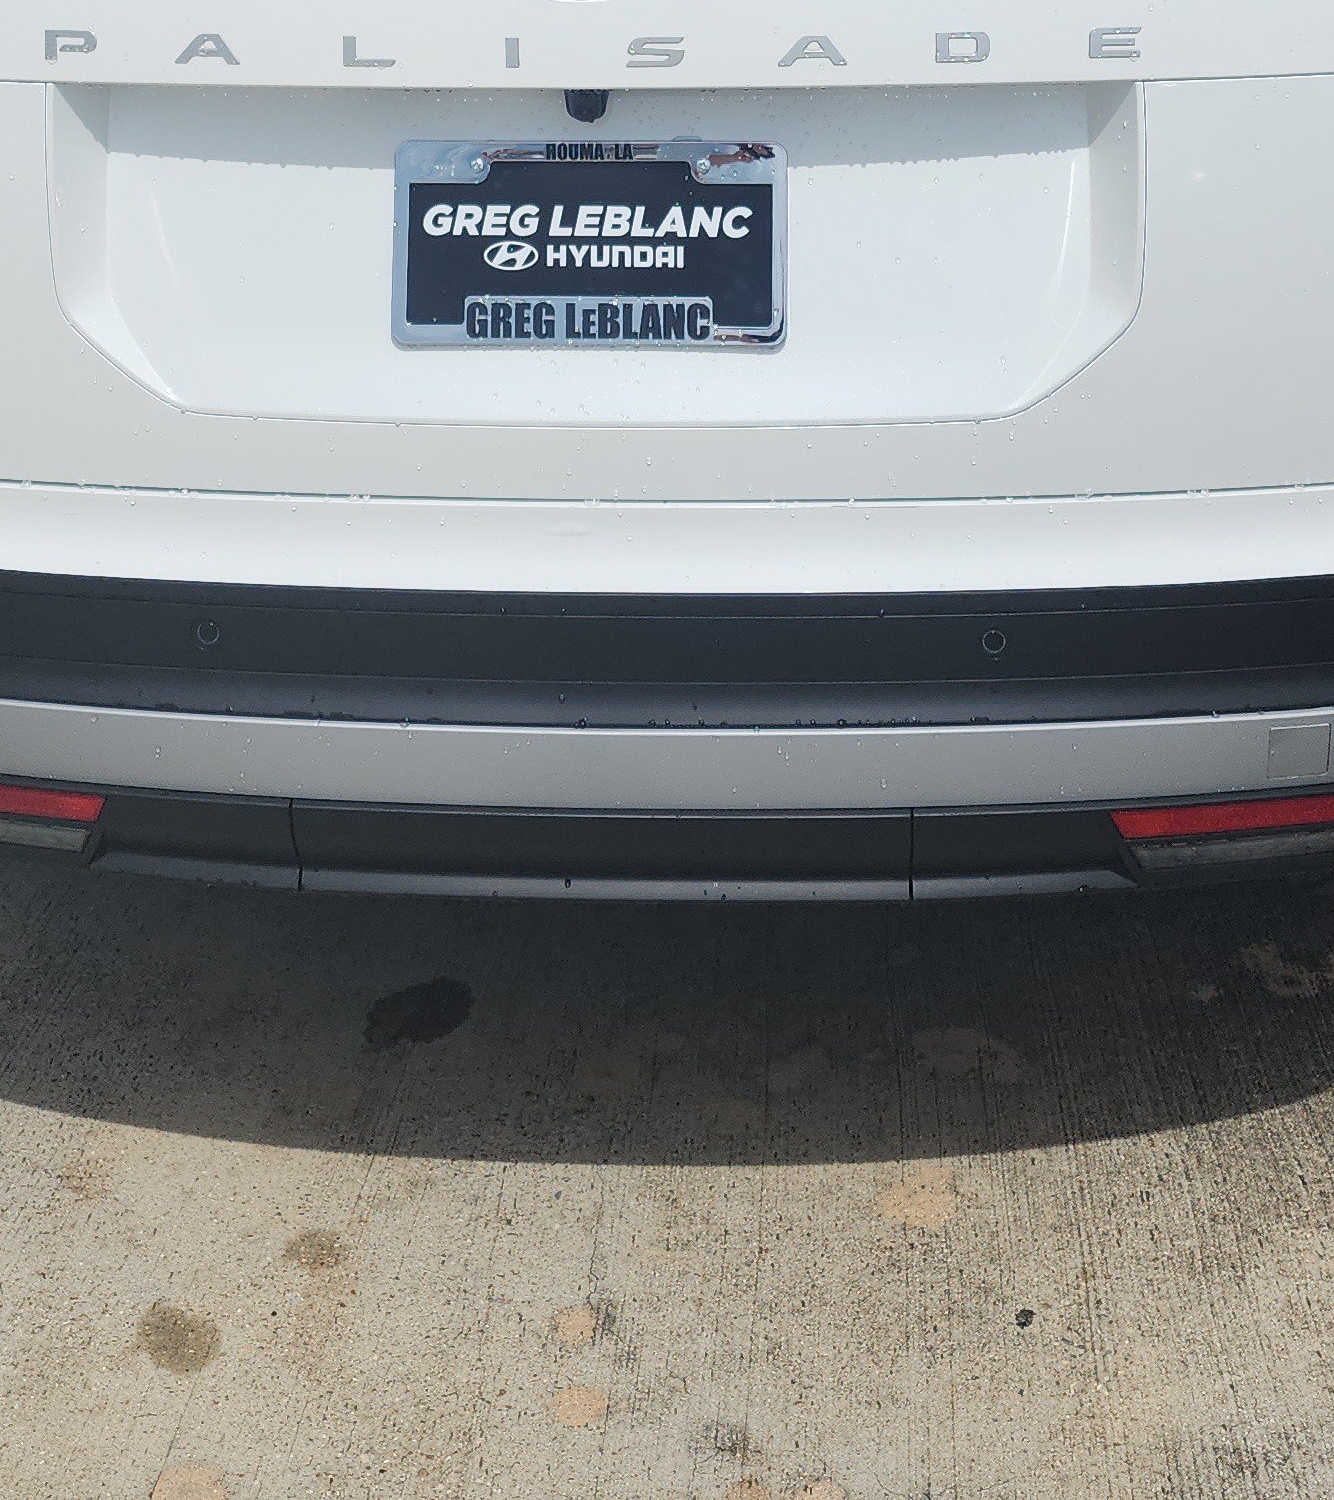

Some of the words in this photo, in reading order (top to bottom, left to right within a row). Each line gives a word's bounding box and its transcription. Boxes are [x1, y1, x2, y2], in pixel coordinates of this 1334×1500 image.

[44, 26, 1142, 70] PALISADE
[613, 143, 634, 161] LA
[422, 204, 540, 237] GREG
[548, 204, 753, 239] LEBLANC
[546, 245, 685, 269] HYUNDAI
[466, 301, 556, 339] GREG
